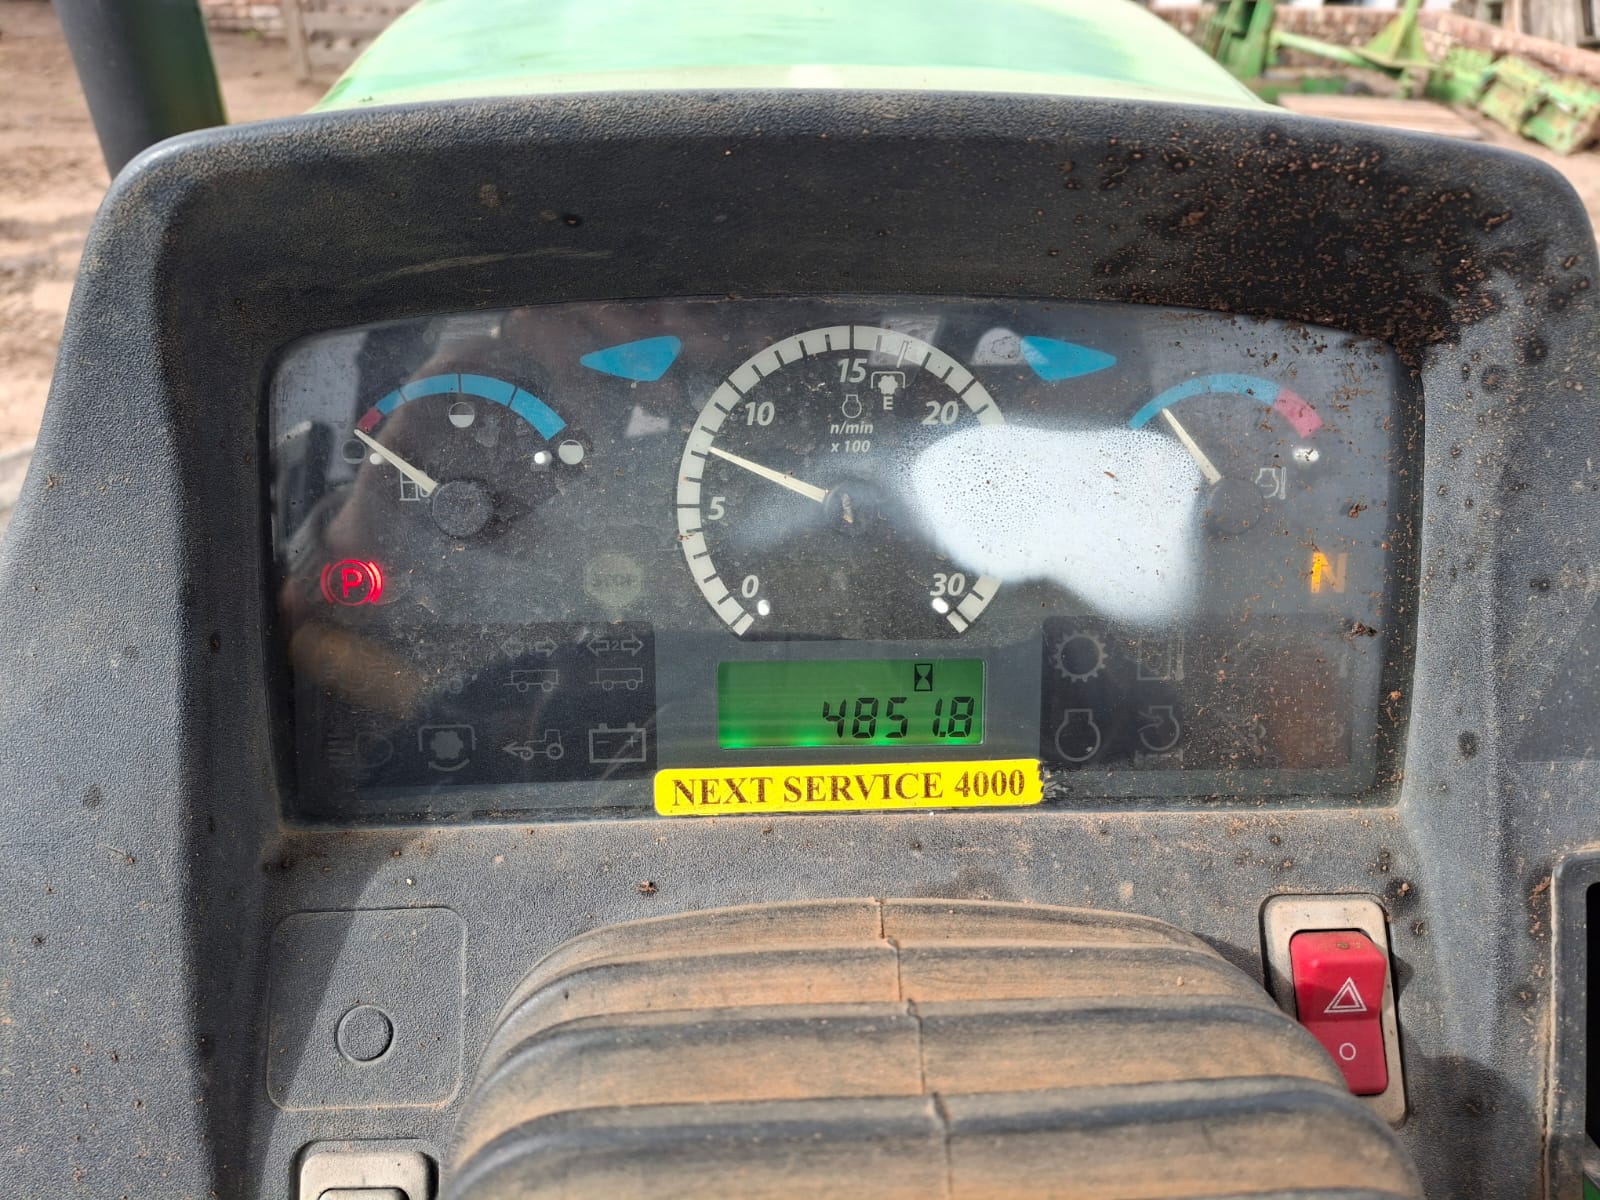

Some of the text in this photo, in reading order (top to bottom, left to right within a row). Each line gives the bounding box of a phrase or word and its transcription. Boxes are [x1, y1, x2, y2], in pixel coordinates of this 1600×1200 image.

[837, 358, 868, 383] 15
[744, 401, 775, 426] 10
[883, 396, 894, 411] E
[922, 401, 960, 426] 20
[830, 420, 874, 435] n/min
[844, 440, 871, 453] 100
[708, 496, 726, 521] 5
[341, 567, 363, 598] P
[929, 573, 966, 597] 30
[1311, 552, 1346, 593] N
[741, 574, 759, 598] 0
[822, 696, 975, 739] 4851.8
[672, 769, 1026, 807] NEXT SERVICE 4000
